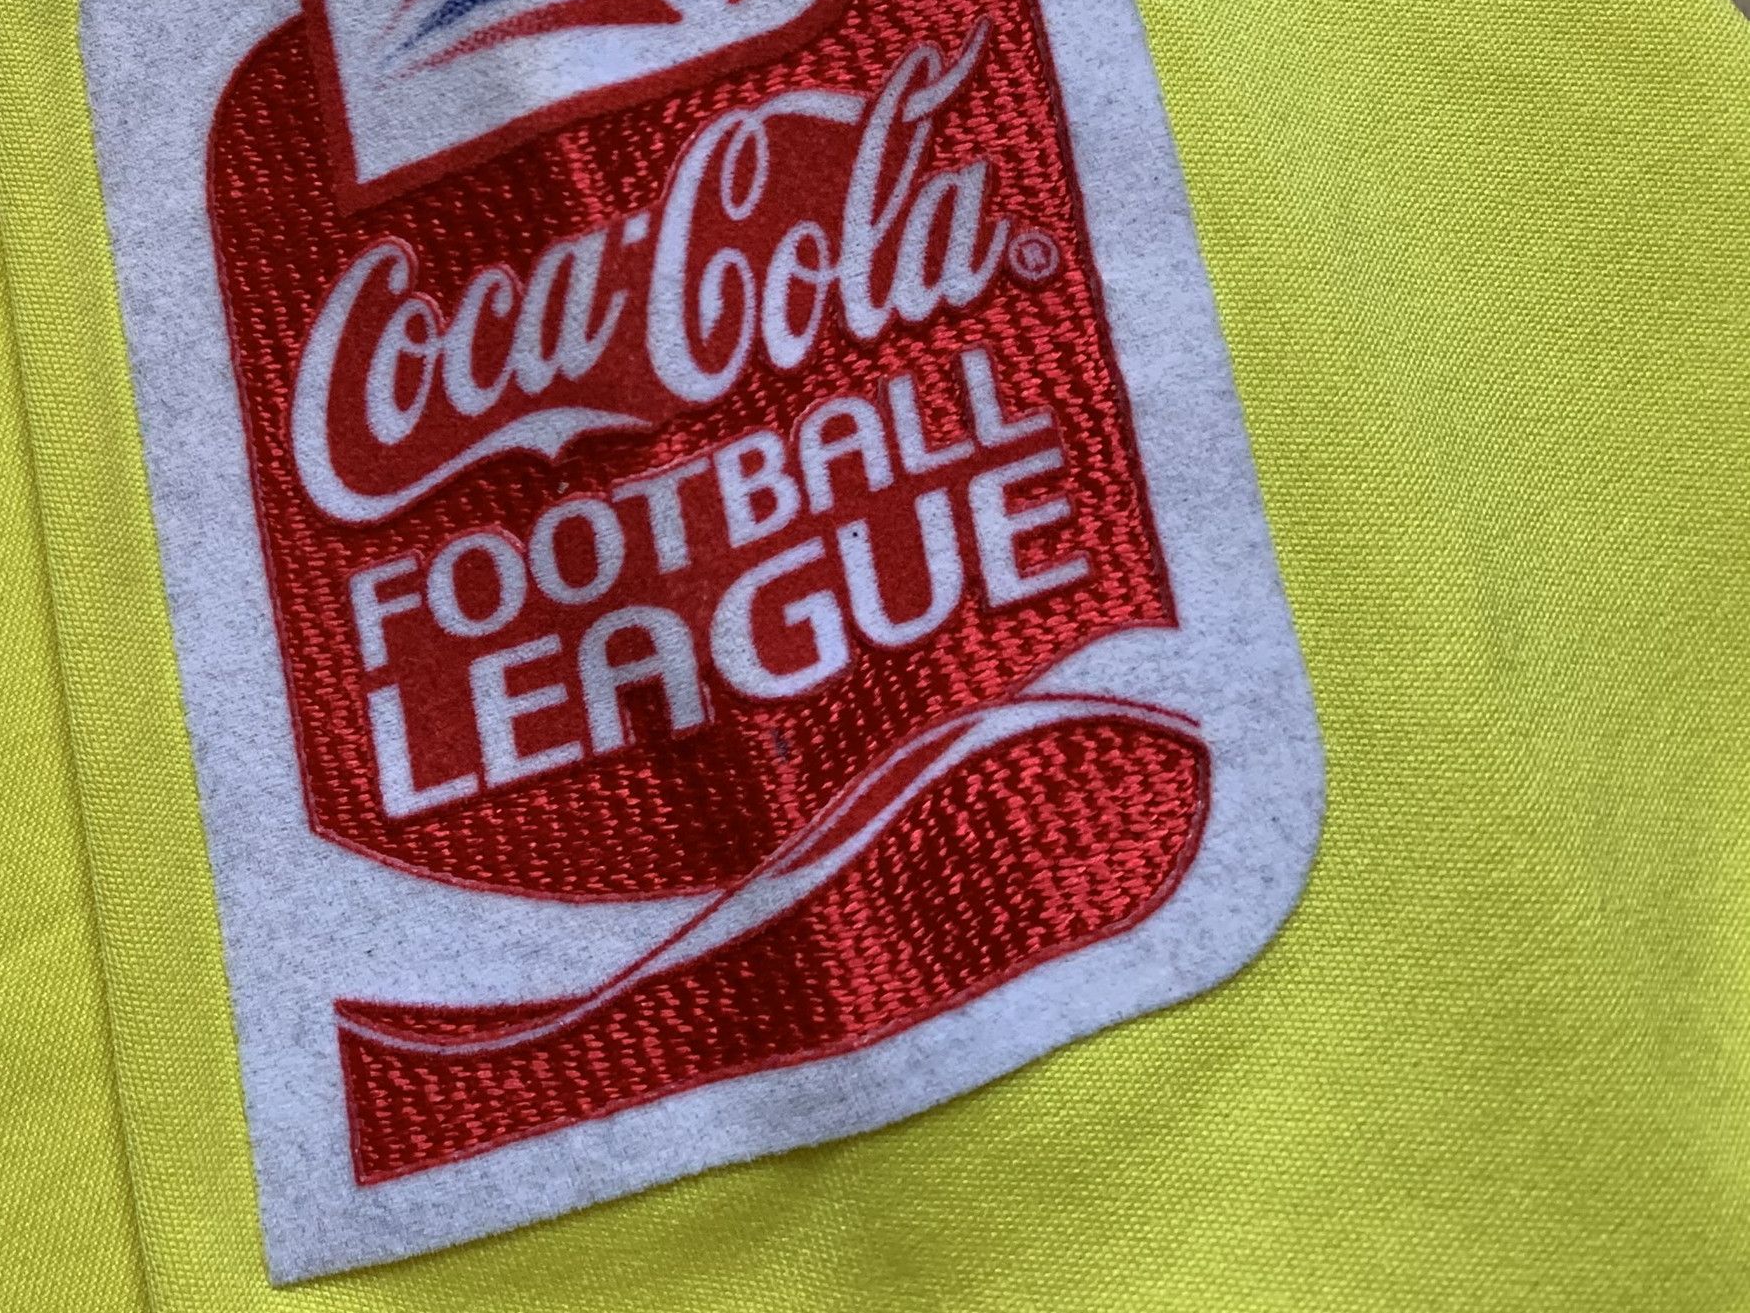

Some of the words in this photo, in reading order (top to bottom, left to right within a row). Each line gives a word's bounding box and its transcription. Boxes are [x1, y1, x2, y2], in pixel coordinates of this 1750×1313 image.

[290, 16, 1012, 525] Coca-Cola
[348, 347, 1053, 673] FOOTBALL
[366, 448, 1090, 819] LEAGUE
